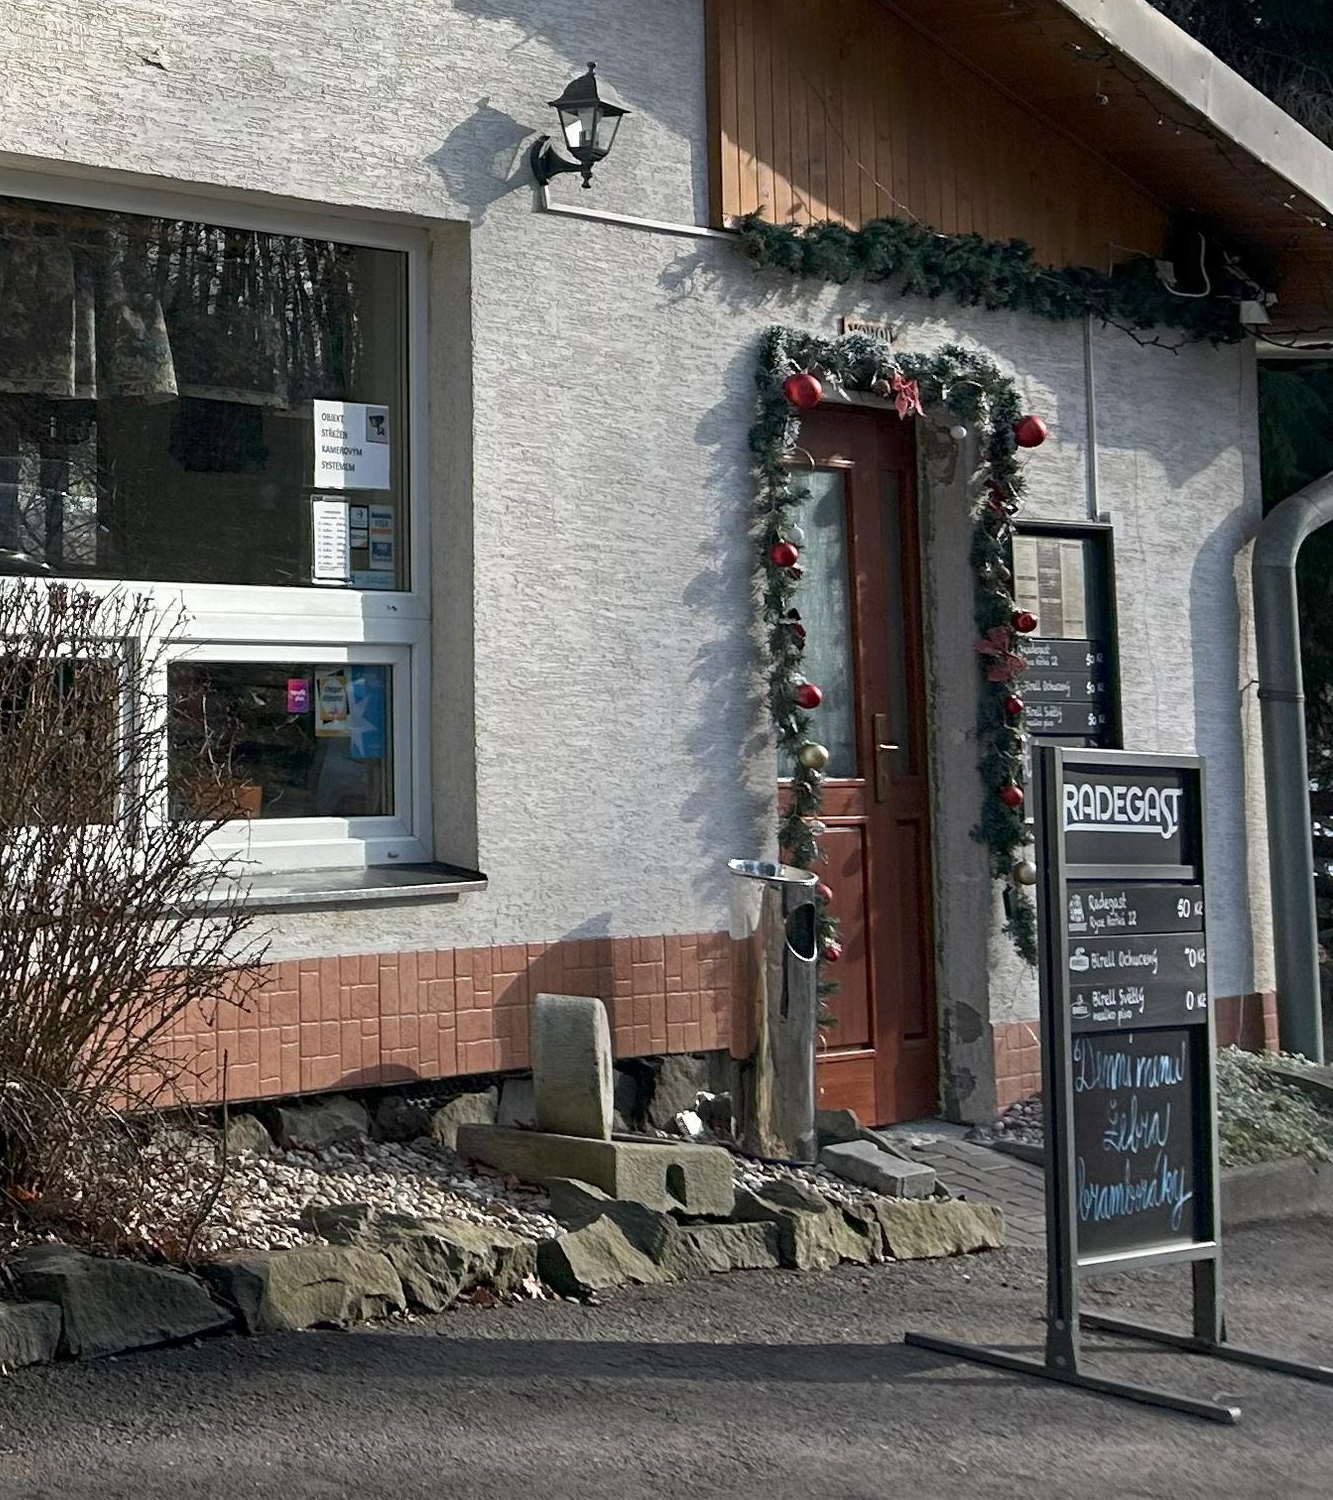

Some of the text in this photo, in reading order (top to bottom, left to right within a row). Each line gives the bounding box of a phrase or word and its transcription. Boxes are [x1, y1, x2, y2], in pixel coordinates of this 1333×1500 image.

[1062, 783, 1183, 839] RADEGAST
[1088, 891, 1127, 916] Radegast
[1177, 898, 1191, 918] 50
[1091, 951, 1116, 969] Birell
[1092, 988, 1117, 1007] Birell
